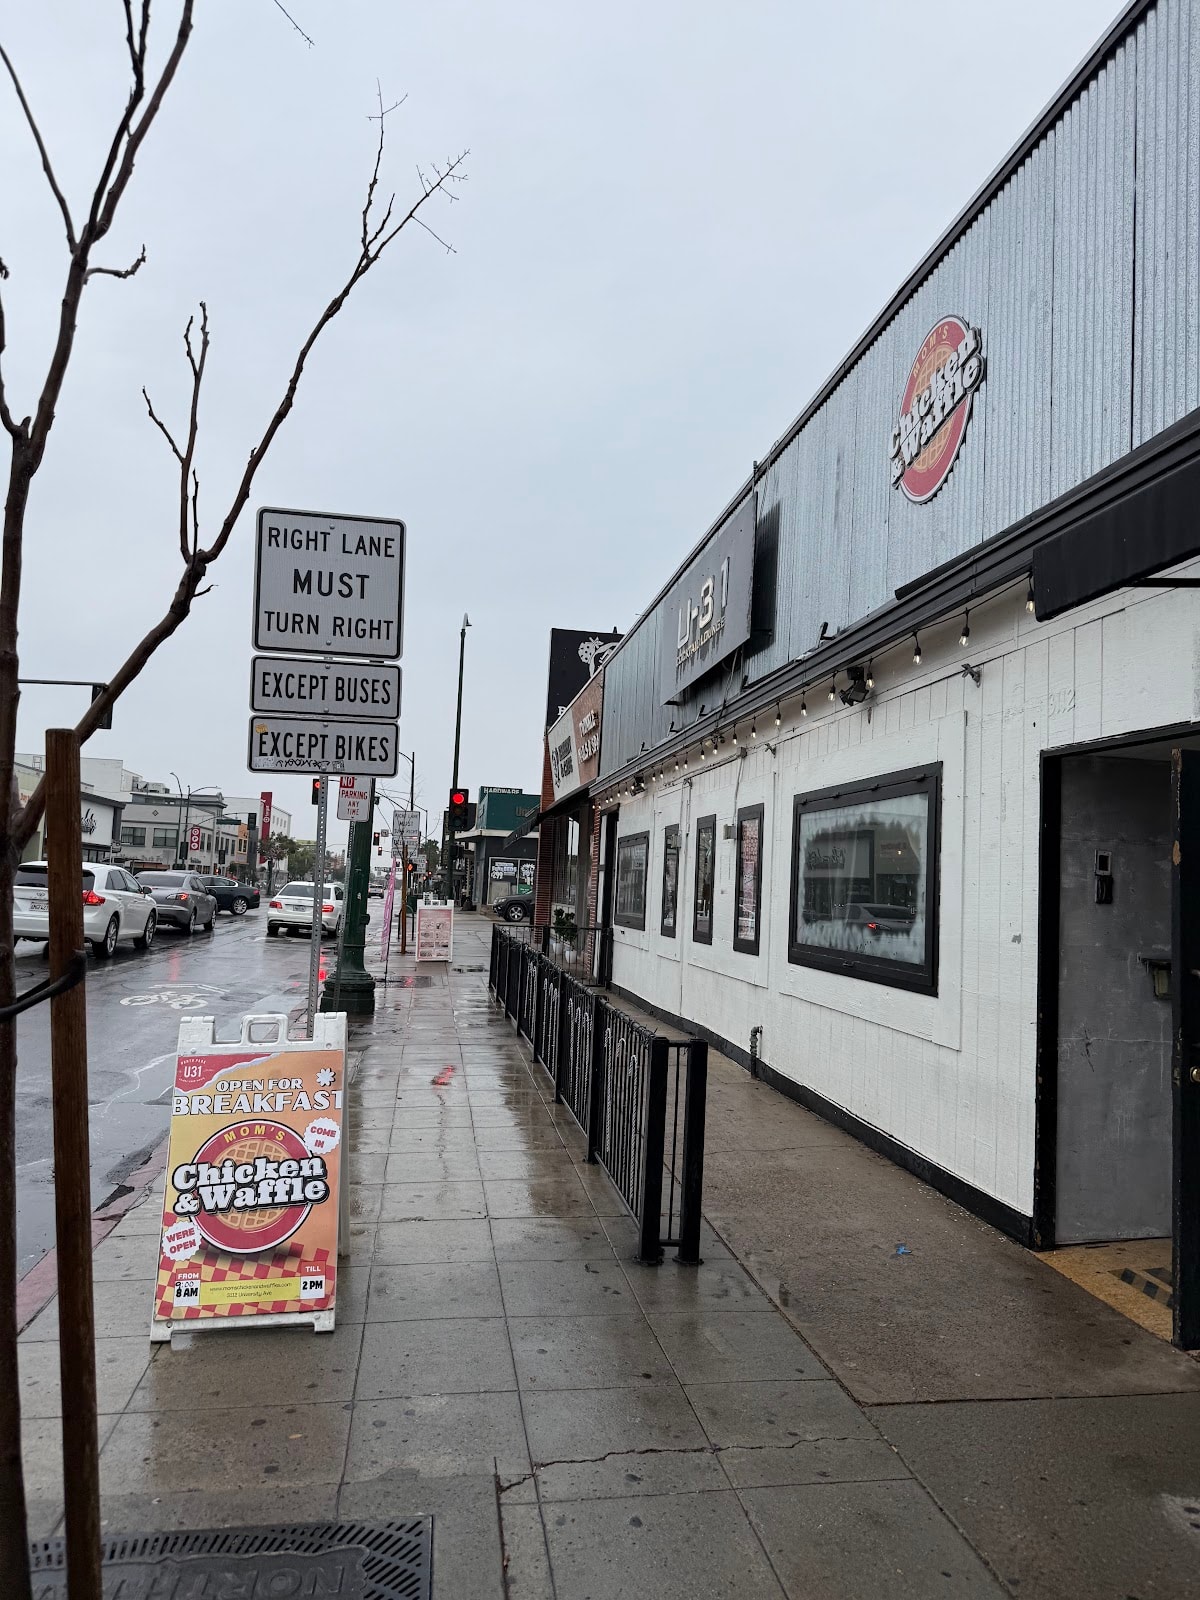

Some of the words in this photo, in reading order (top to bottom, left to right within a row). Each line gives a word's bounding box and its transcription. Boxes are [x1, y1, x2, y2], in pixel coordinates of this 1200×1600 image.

[912, 325, 949, 379] MOM'S
[268, 526, 331, 552] RIGHT
[342, 533, 396, 558] LANE
[293, 568, 370, 600] MUST
[264, 611, 320, 635] TURN
[332, 616, 394, 640] RIGHT
[262, 671, 329, 701] EXCEPT
[335, 676, 391, 705] BUSES
[258, 731, 329, 760] EXCEPT
[335, 735, 389, 762] BIKES
[341, 776, 354, 788] NO
[341, 789, 368, 800] PARKING
[347, 800, 360, 808] ANY
[347, 808, 360, 816] TIME
[184, 1065, 202, 1078] U31
[216, 1079, 265, 1093] OPEN
[268, 1078, 303, 1091] FOR
[172, 1090, 342, 1116] BREAKFAST
[223, 1124, 287, 1144] MOM'S
[310, 1125, 337, 1138] COME
[314, 1139, 325, 1149] IN
[173, 1156, 326, 1191] Chicken
[174, 1192, 200, 1214] &
[199, 1176, 328, 1212] Waffle
[165, 1227, 196, 1243] WERE
[169, 1239, 197, 1255] OPEN
[178, 1272, 199, 1280] FROM
[304, 1265, 321, 1273] TILL
[176, 1287, 182, 1298] 8
[183, 1287, 199, 1298] AM
[302, 1281, 308, 1291] 2
[309, 1280, 323, 1291] PM
